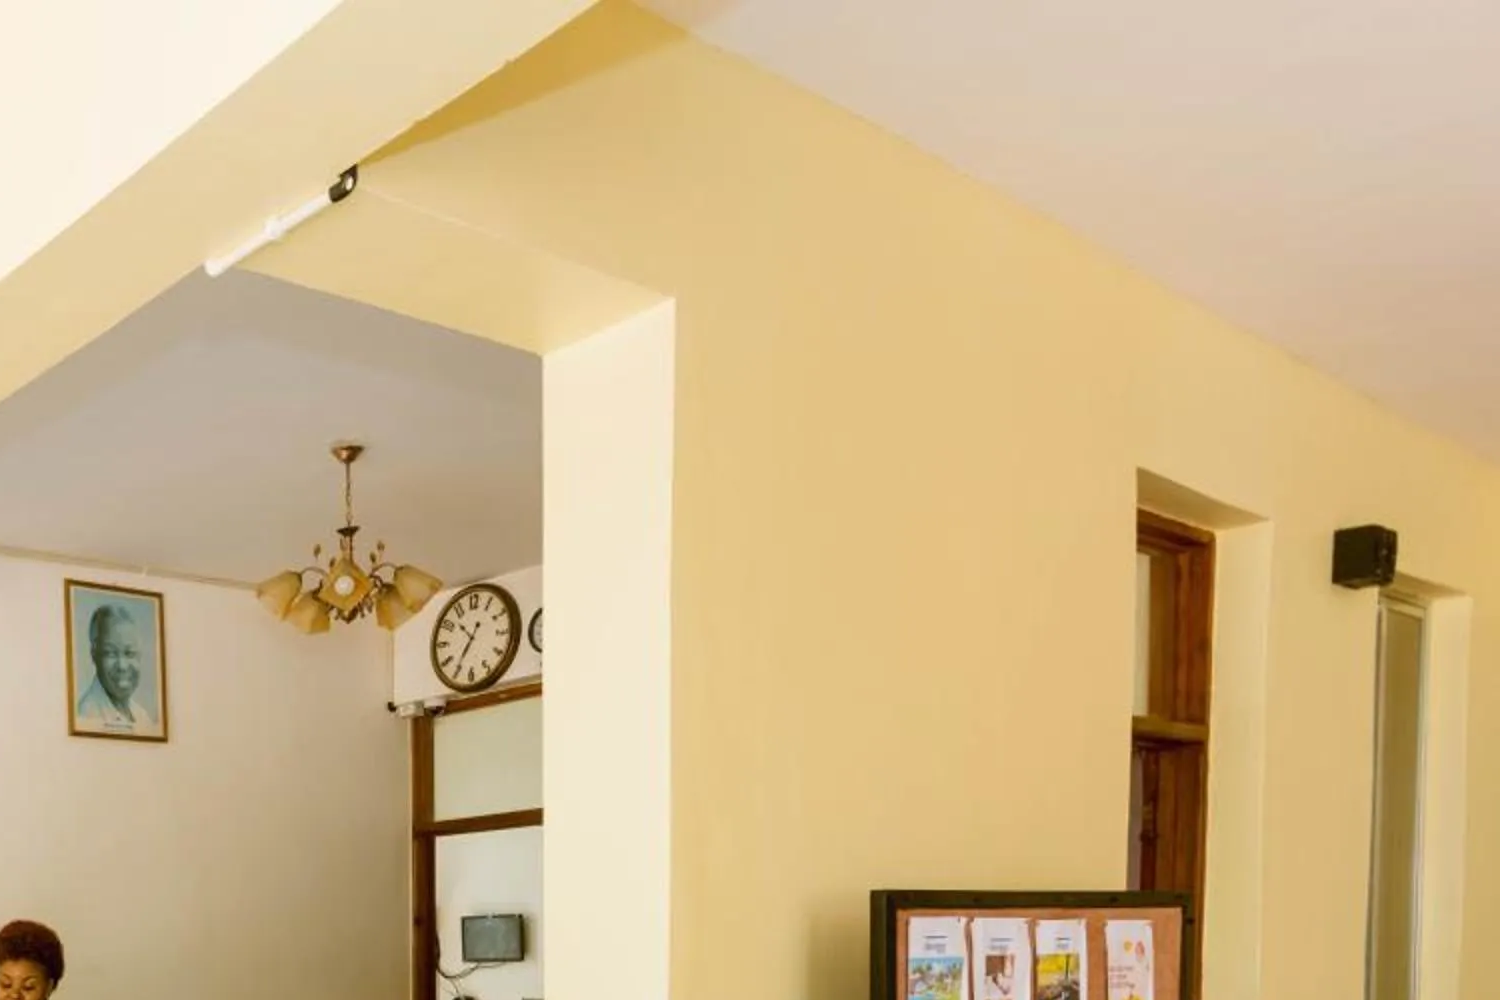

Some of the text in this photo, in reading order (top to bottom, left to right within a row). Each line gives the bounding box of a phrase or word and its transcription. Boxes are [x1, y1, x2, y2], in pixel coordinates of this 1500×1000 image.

[469, 593, 479, 610] 12
[484, 596, 493, 611] 1
[453, 603, 465, 619] 11
